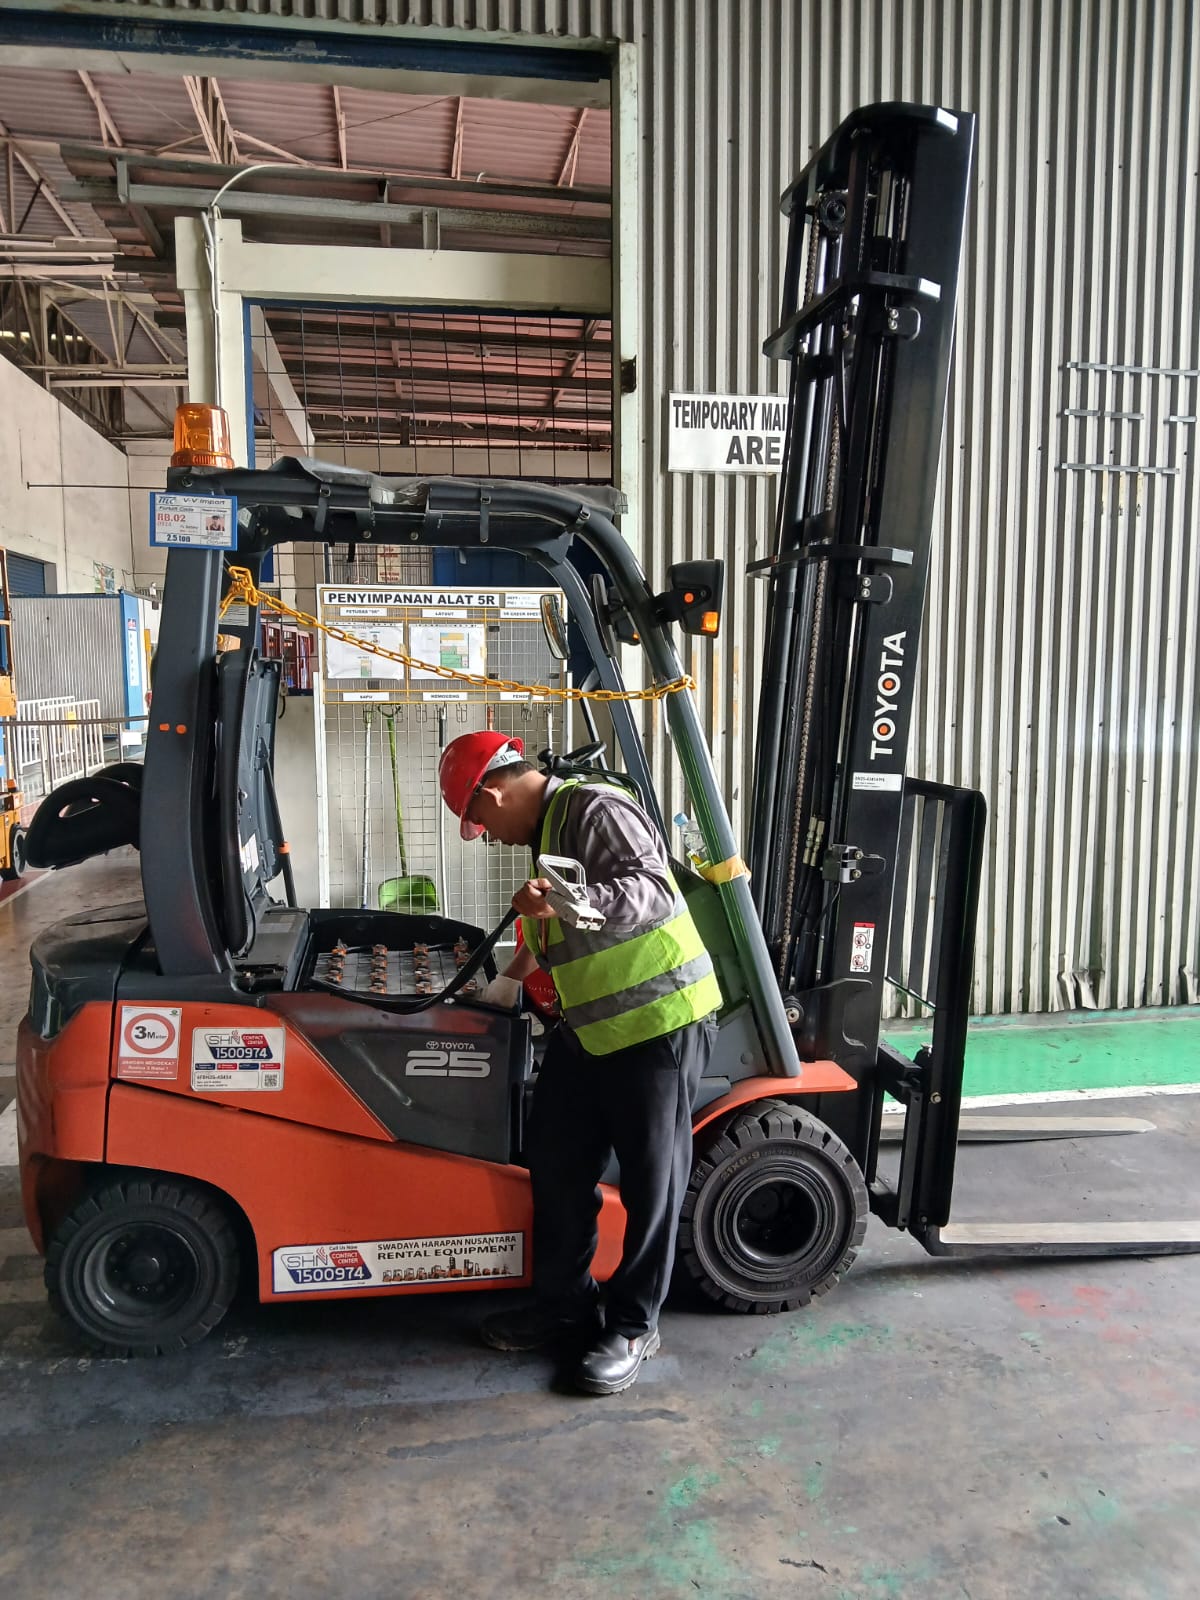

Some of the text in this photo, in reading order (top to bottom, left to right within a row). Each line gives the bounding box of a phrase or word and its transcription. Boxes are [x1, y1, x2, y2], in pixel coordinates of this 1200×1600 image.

[672, 400, 758, 430] TEMPORARY
[328, 593, 495, 605] PENYIMPANAN ALAT 5R
[870, 630, 906, 760] TOYOTA
[208, 1034, 240, 1045] SHN
[440, 1042, 476, 1050] TOYOTA
[215, 1048, 268, 1058] 1500974
[406, 1050, 491, 1078] 25
[377, 1235, 516, 1250] SWADAYA HARAPAN NUSANTARA
[377, 1244, 516, 1260] RENTAL EQUIPMENT
[287, 1254, 328, 1268] SHN
[296, 1266, 364, 1283] 1500974
